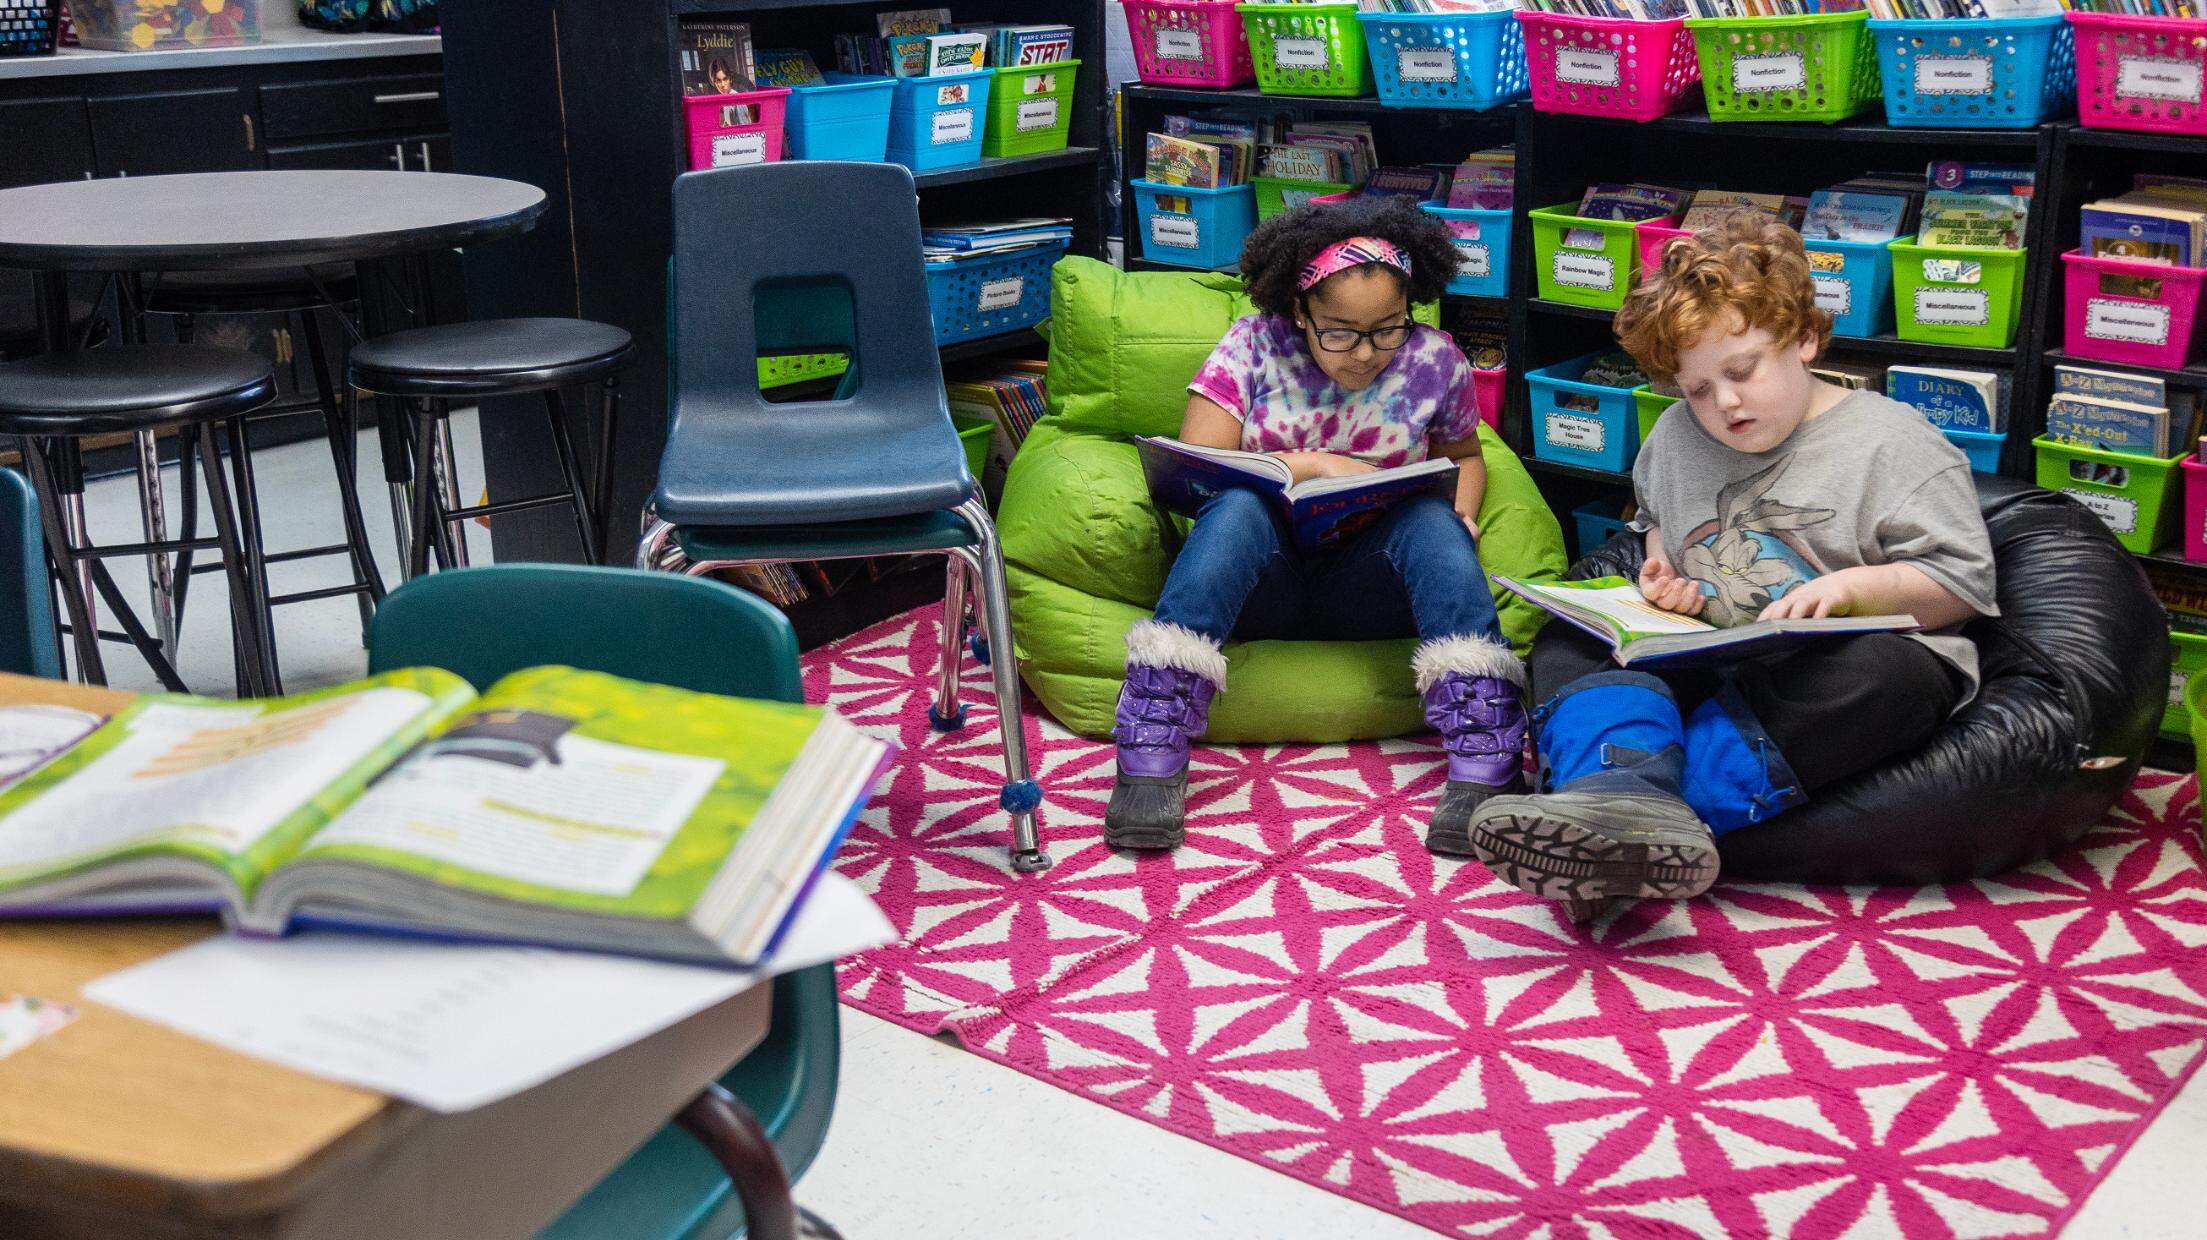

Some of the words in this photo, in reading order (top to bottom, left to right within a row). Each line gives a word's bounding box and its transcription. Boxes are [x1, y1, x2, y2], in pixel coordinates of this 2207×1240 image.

[697, 33, 735, 52] Lyddie
[1168, 39, 1191, 47] Nonfiction
[1020, 41, 1068, 66] STAT
[1287, 48, 1315, 57] Nonfiction
[1413, 59, 1442, 68] Nonfiction
[1571, 61, 1602, 70] Nonfiction
[1750, 67, 1786, 76] Nonfiction
[1934, 70, 1973, 79] Nonfiction
[2140, 73, 2182, 83] Nonfiction
[1024, 110, 1052, 119] Miscellaneous
[721, 147, 758, 157] Miscellaneous
[1266, 160, 1321, 176] HOLIDAY
[1946, 169, 1956, 181] 3
[1158, 227, 1192, 236] Miscellaneous
[1561, 265, 1587, 275] Rainbow
[1588, 268, 1606, 277] Magic
[1926, 302, 1976, 311] Miscellaneous
[2100, 316, 2155, 327] Miscellaneous
[1919, 380, 1964, 396] DIARY
[1931, 395, 1943, 406] of
[1914, 402, 1953, 426] impy
[1954, 405, 1980, 426] Kid
[1558, 422, 1576, 432] Magic
[1577, 425, 1591, 433] Tree
[1565, 431, 1584, 441] House
